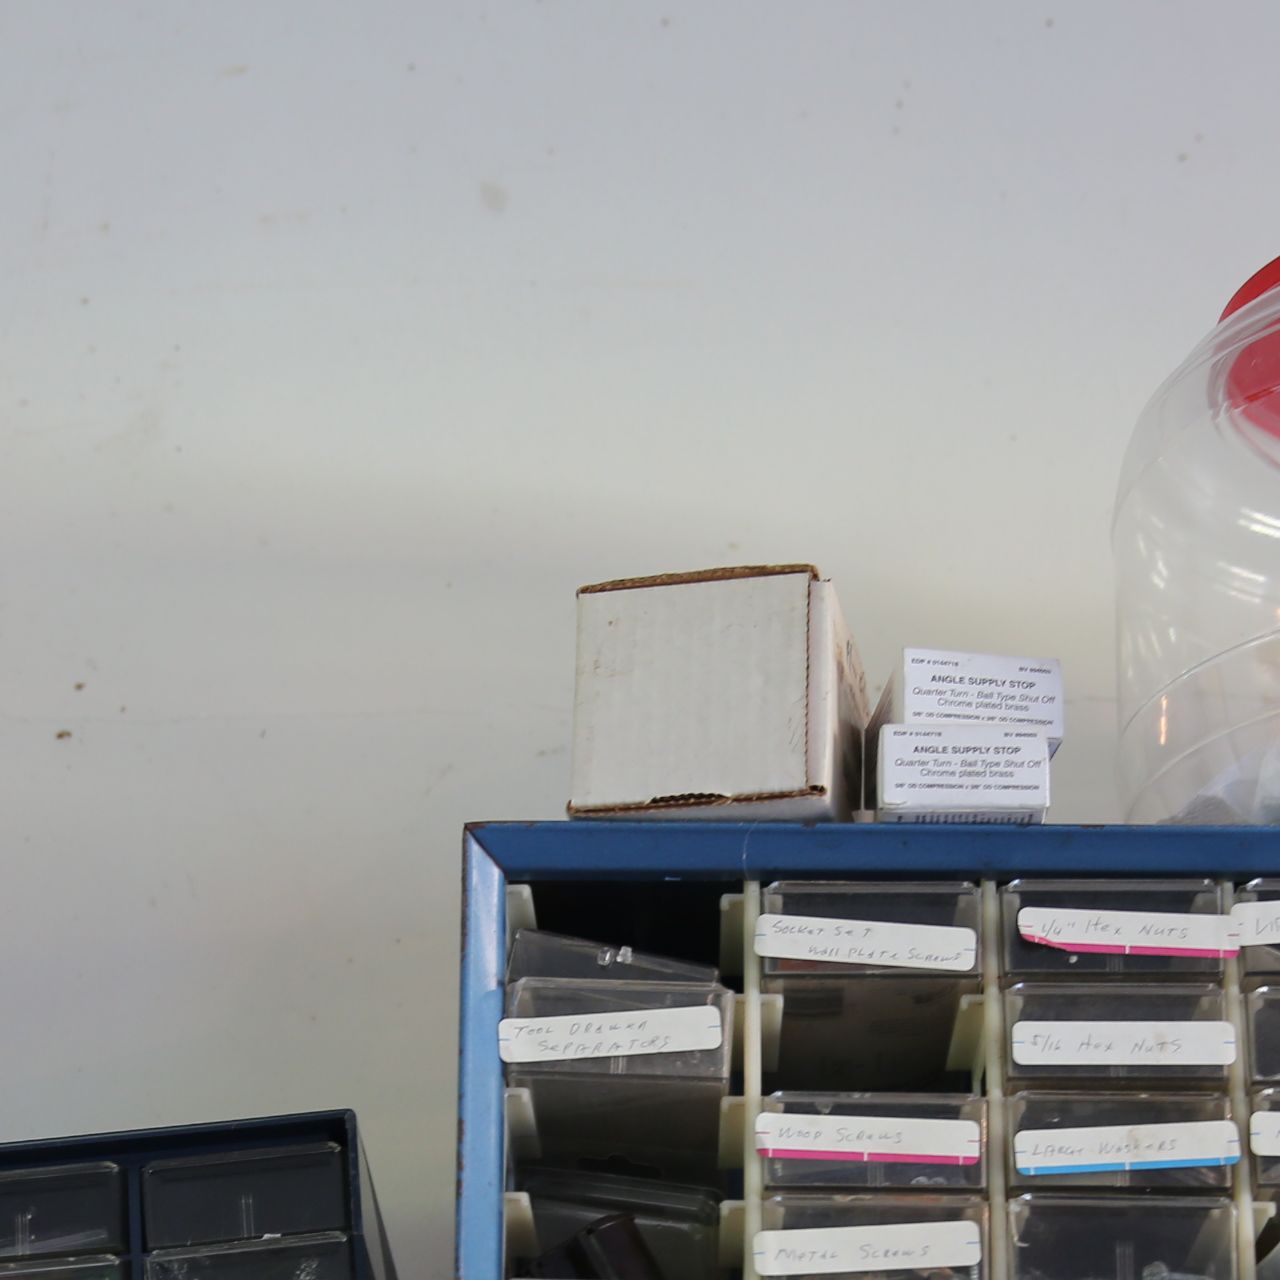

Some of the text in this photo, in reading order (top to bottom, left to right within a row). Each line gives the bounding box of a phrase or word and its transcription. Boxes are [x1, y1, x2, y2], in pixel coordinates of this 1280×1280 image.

[930, 674, 1037, 690] ANGLE SUPPLY STOP
[911, 686, 948, 697] Quarter
[949, 688, 969, 699] Turn
[976, 690, 994, 700] Ball
[996, 691, 1017, 703] Type
[1018, 693, 1039, 704] Shut
[1041, 695, 1056, 705] Off
[936, 697, 1031, 713] Chrome plated brass
[935, 712, 980, 721] COMPRESSION
[1008, 716, 1054, 726] COMPRESSION
[912, 745, 1022, 756] ANGLE SUPPLY STOP
[893, 758, 930, 768] Quarter
[932, 758, 953, 768] Turn
[959, 759, 978, 768] Ball
[980, 759, 1002, 769] Type
[1003, 759, 1025, 769] Shut
[1026, 759, 1042, 769] Off
[919, 768, 1015, 779] Chrome plated brass
[1040, 918, 1076, 938] 1/4"
[1031, 1033, 1062, 1054] 5/16
